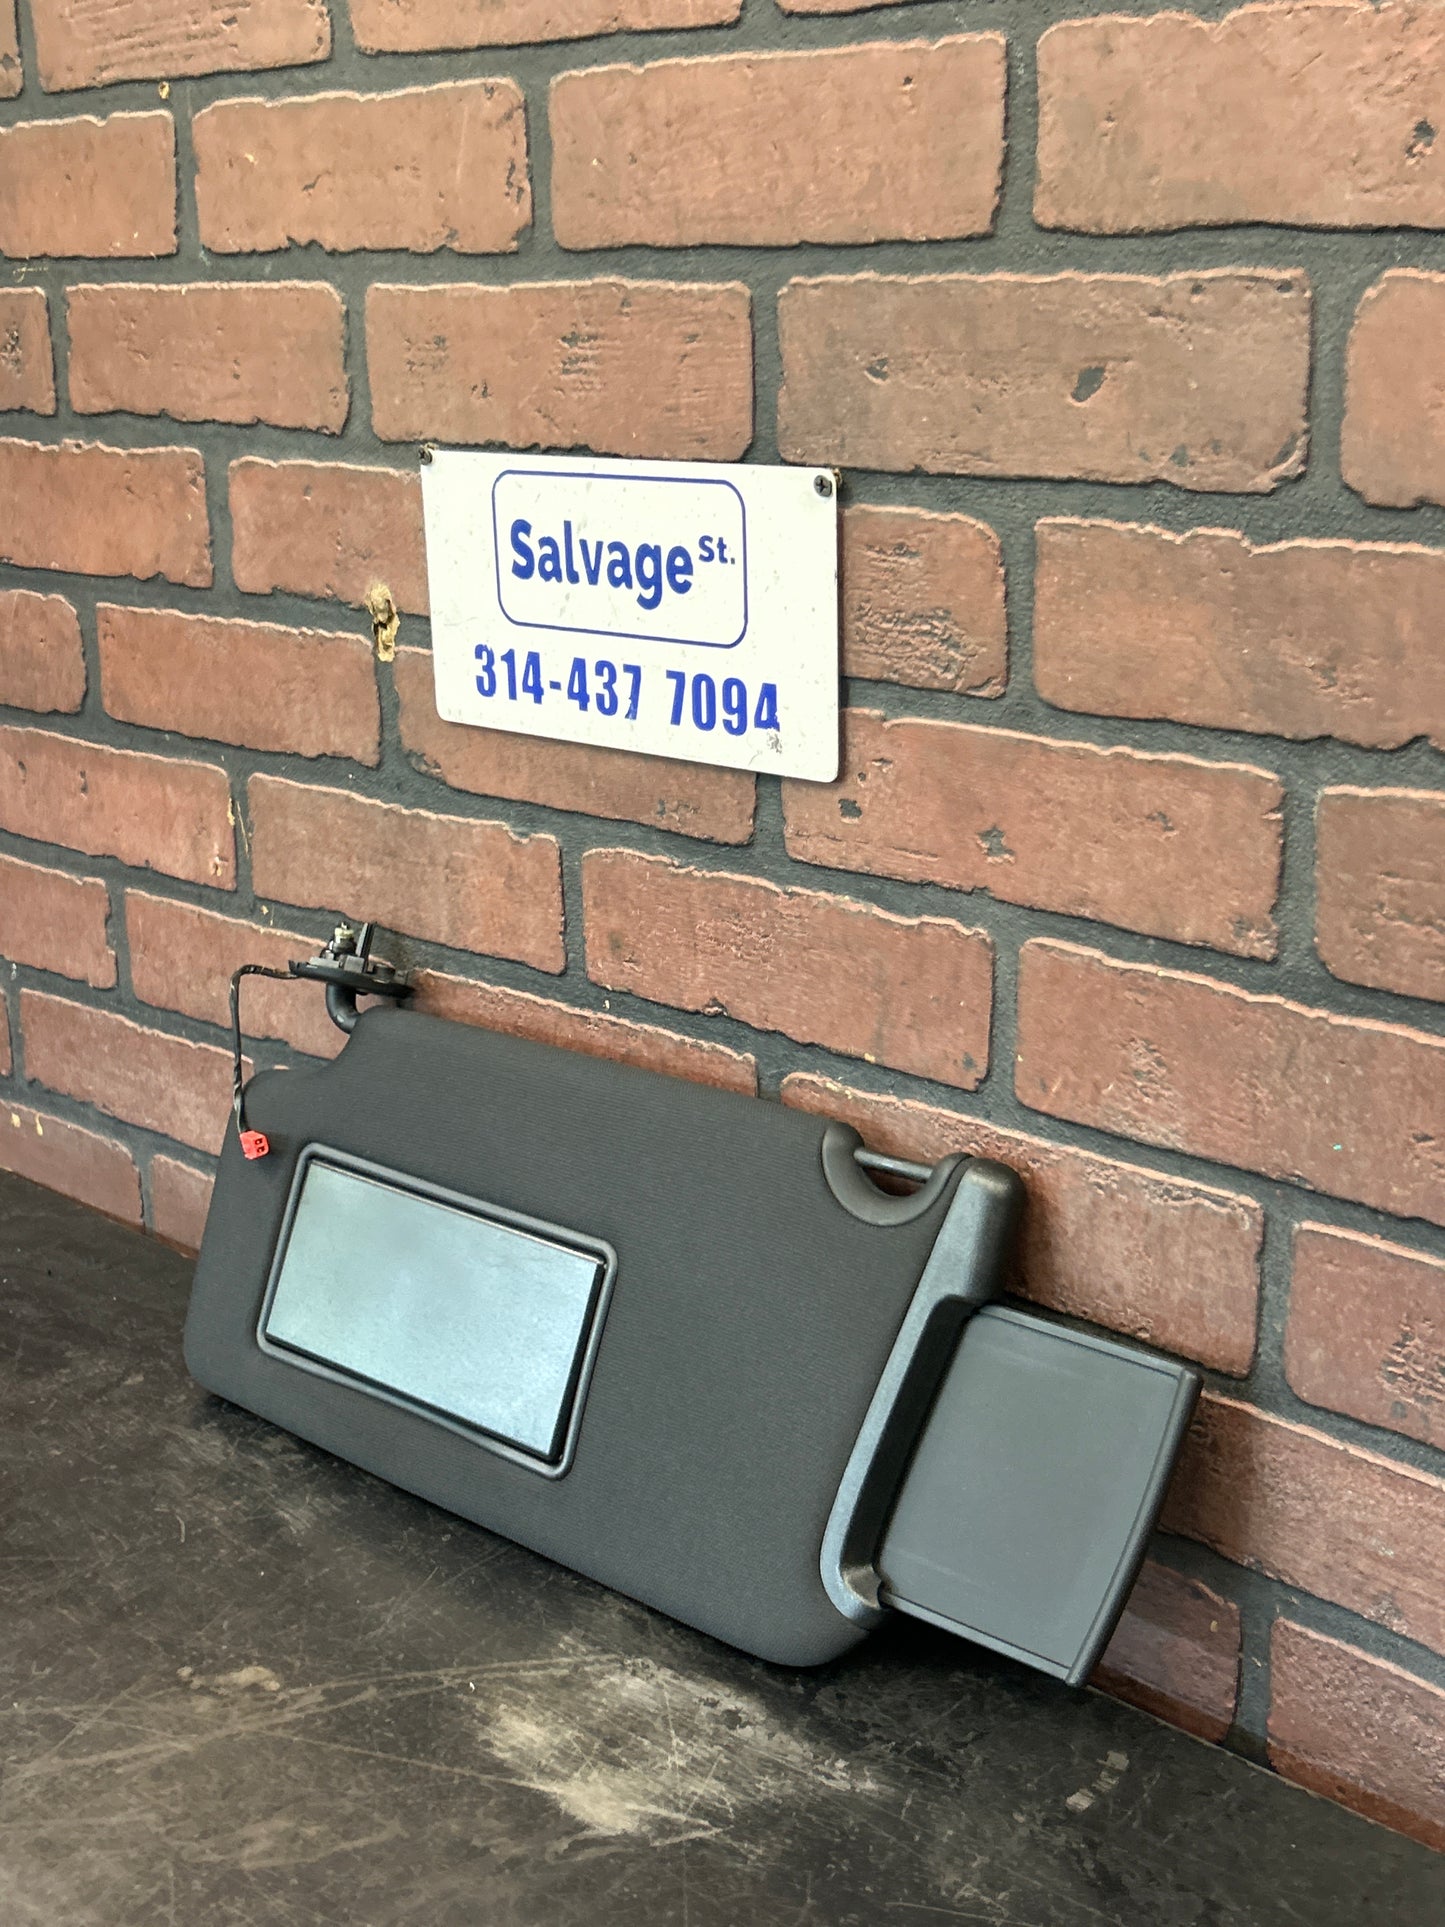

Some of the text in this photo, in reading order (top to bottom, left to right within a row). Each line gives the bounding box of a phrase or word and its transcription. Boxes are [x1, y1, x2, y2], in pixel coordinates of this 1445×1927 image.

[510, 519, 736, 610] Salvage St.
[474, 644, 781, 736] 314-437 7094
